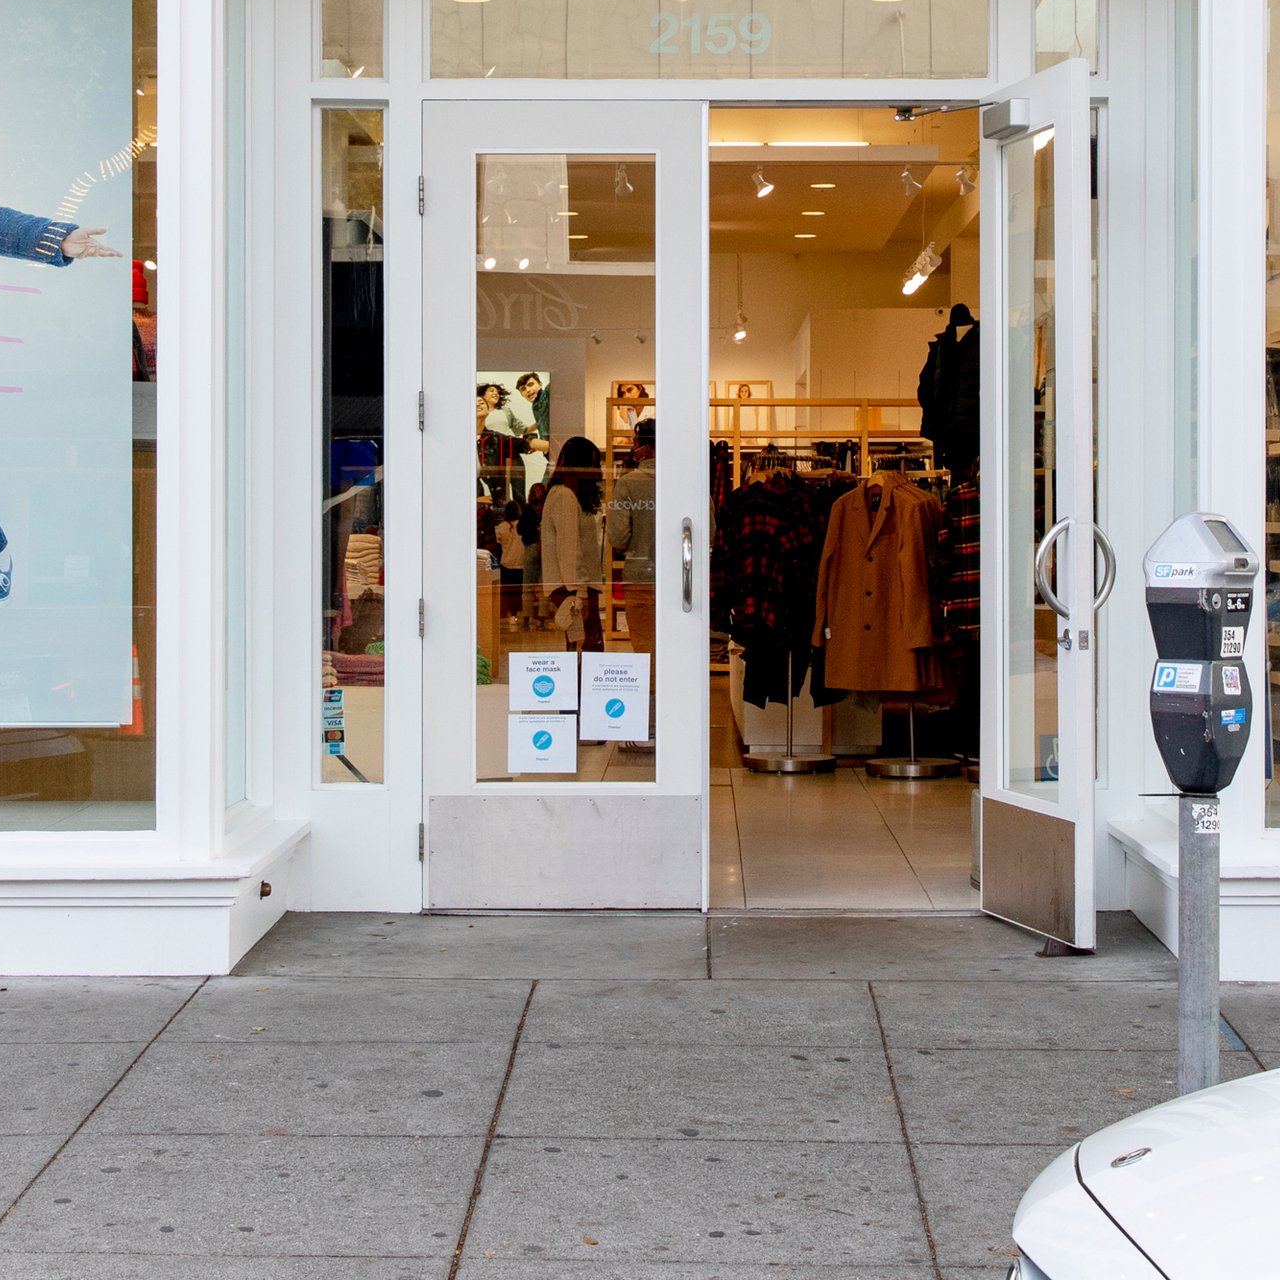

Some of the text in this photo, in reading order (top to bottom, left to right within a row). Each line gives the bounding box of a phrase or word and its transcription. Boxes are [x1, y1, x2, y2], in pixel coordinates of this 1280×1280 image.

[649, 12, 772, 54] 2159
[1224, 630, 1235, 641] 354
[1223, 642, 1241, 654] 21290
[603, 668, 629, 676] please
